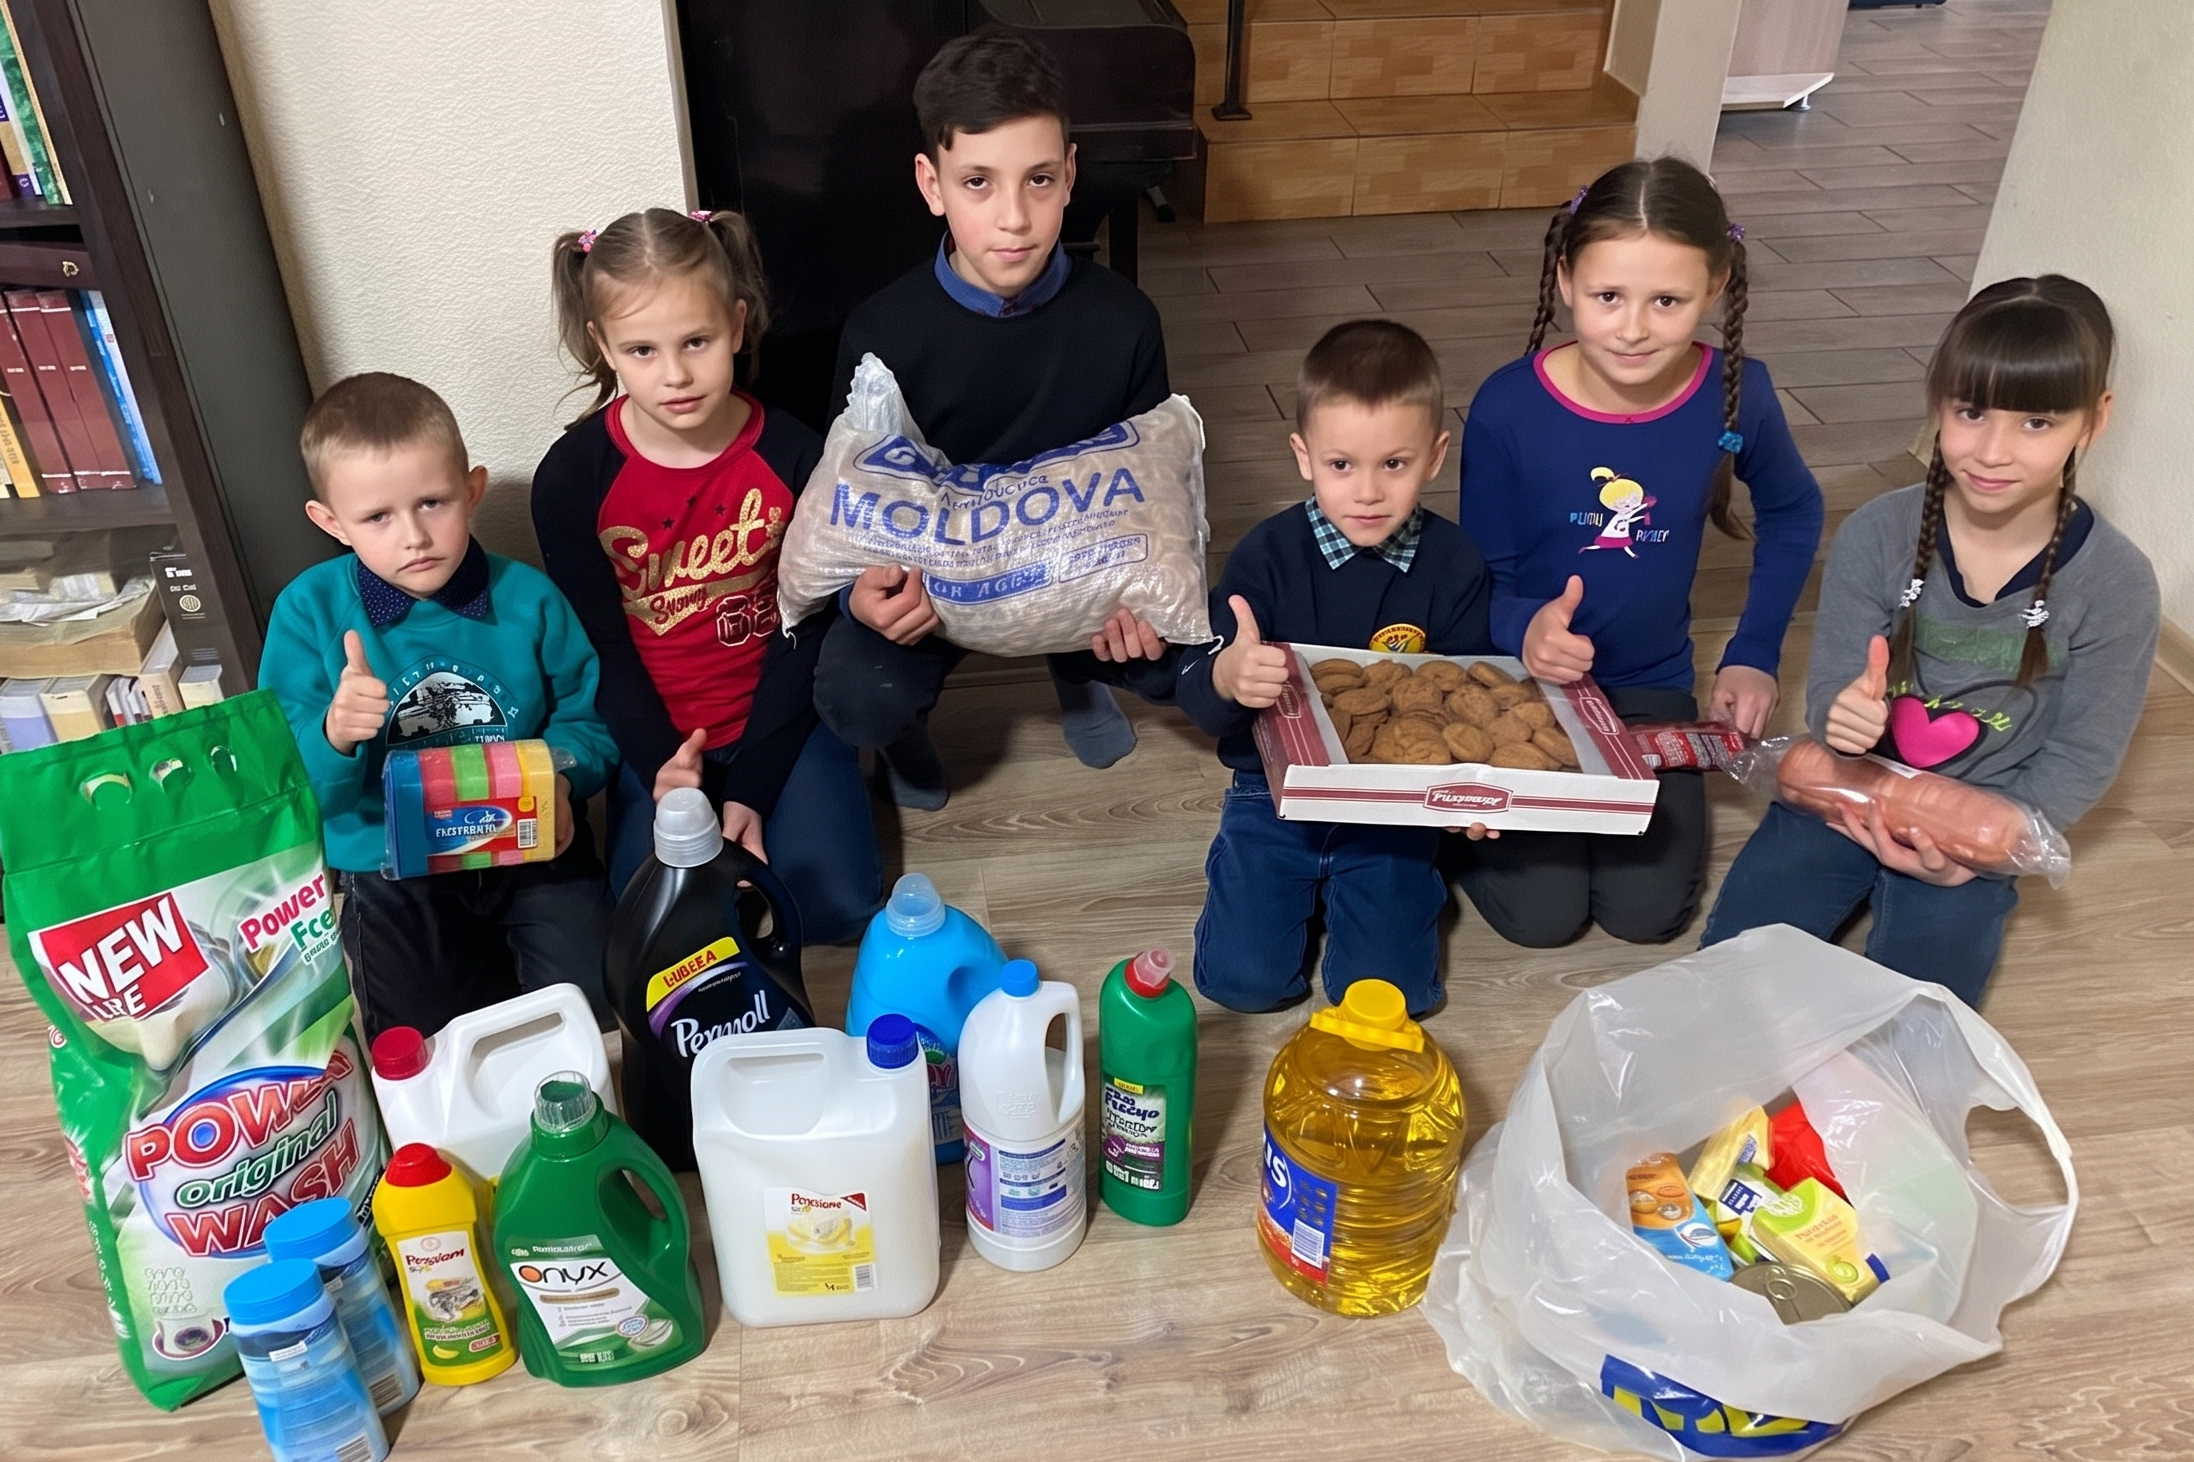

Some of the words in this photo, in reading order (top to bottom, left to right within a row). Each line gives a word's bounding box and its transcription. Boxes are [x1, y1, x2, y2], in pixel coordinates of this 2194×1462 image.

[830, 467, 1145, 546] MOLDOVA
[57, 896, 183, 1004] NEW
[240, 873, 325, 950] Power
[167, 1117, 360, 1257] WASH
[177, 1089, 338, 1209] original
